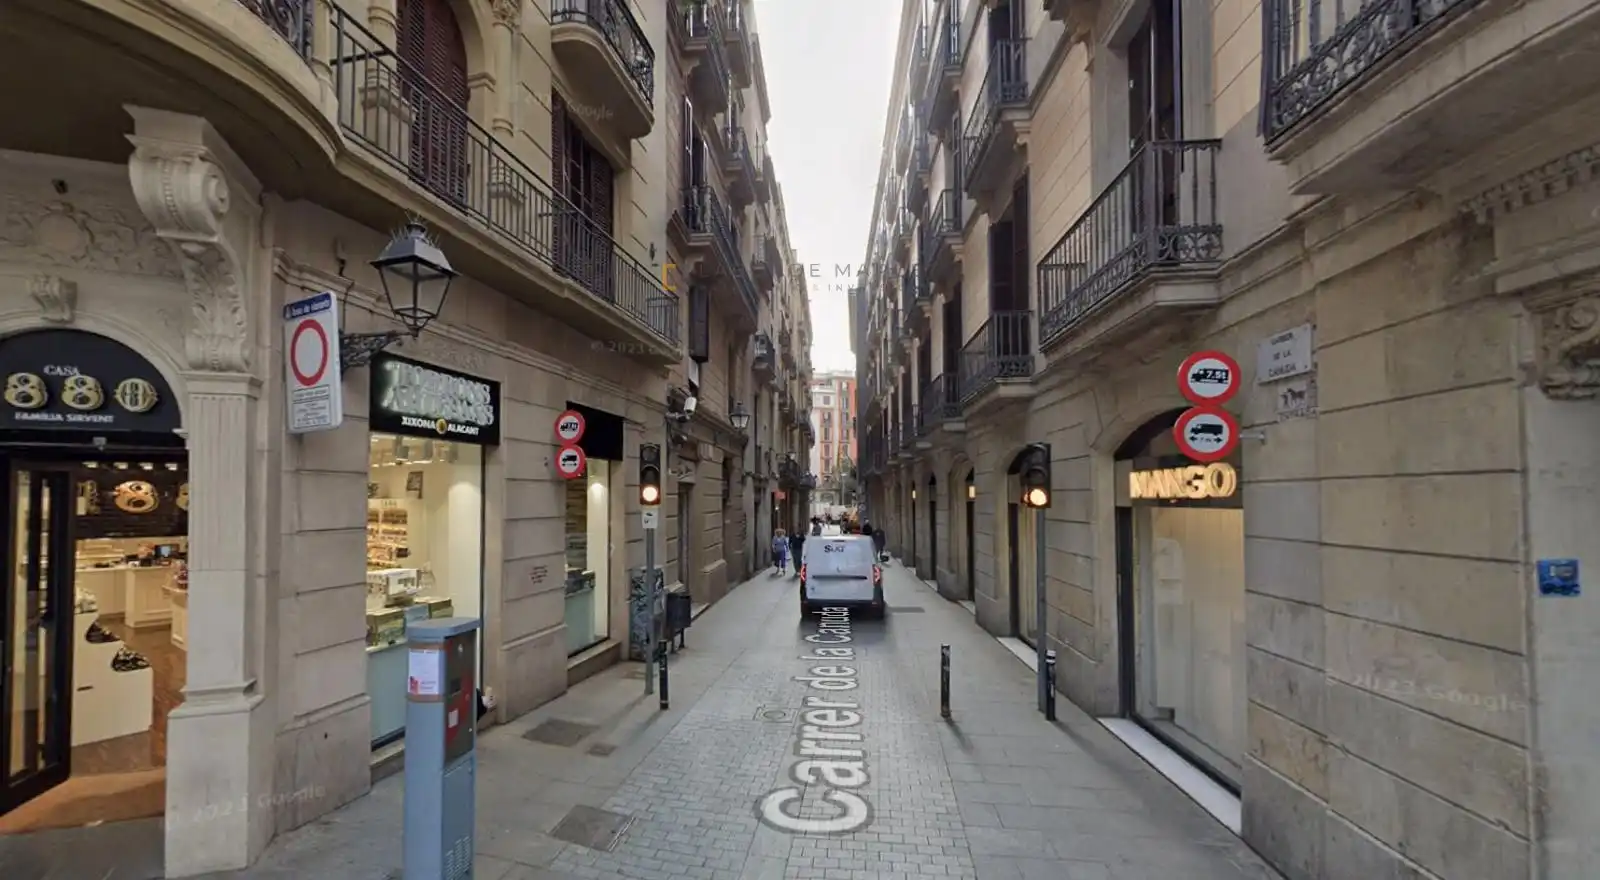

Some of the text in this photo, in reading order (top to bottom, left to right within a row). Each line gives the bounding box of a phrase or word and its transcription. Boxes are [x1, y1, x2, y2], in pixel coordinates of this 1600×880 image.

[44, 364, 81, 377] CASA
[402, 416, 480, 436] XIXONA ALACANT
